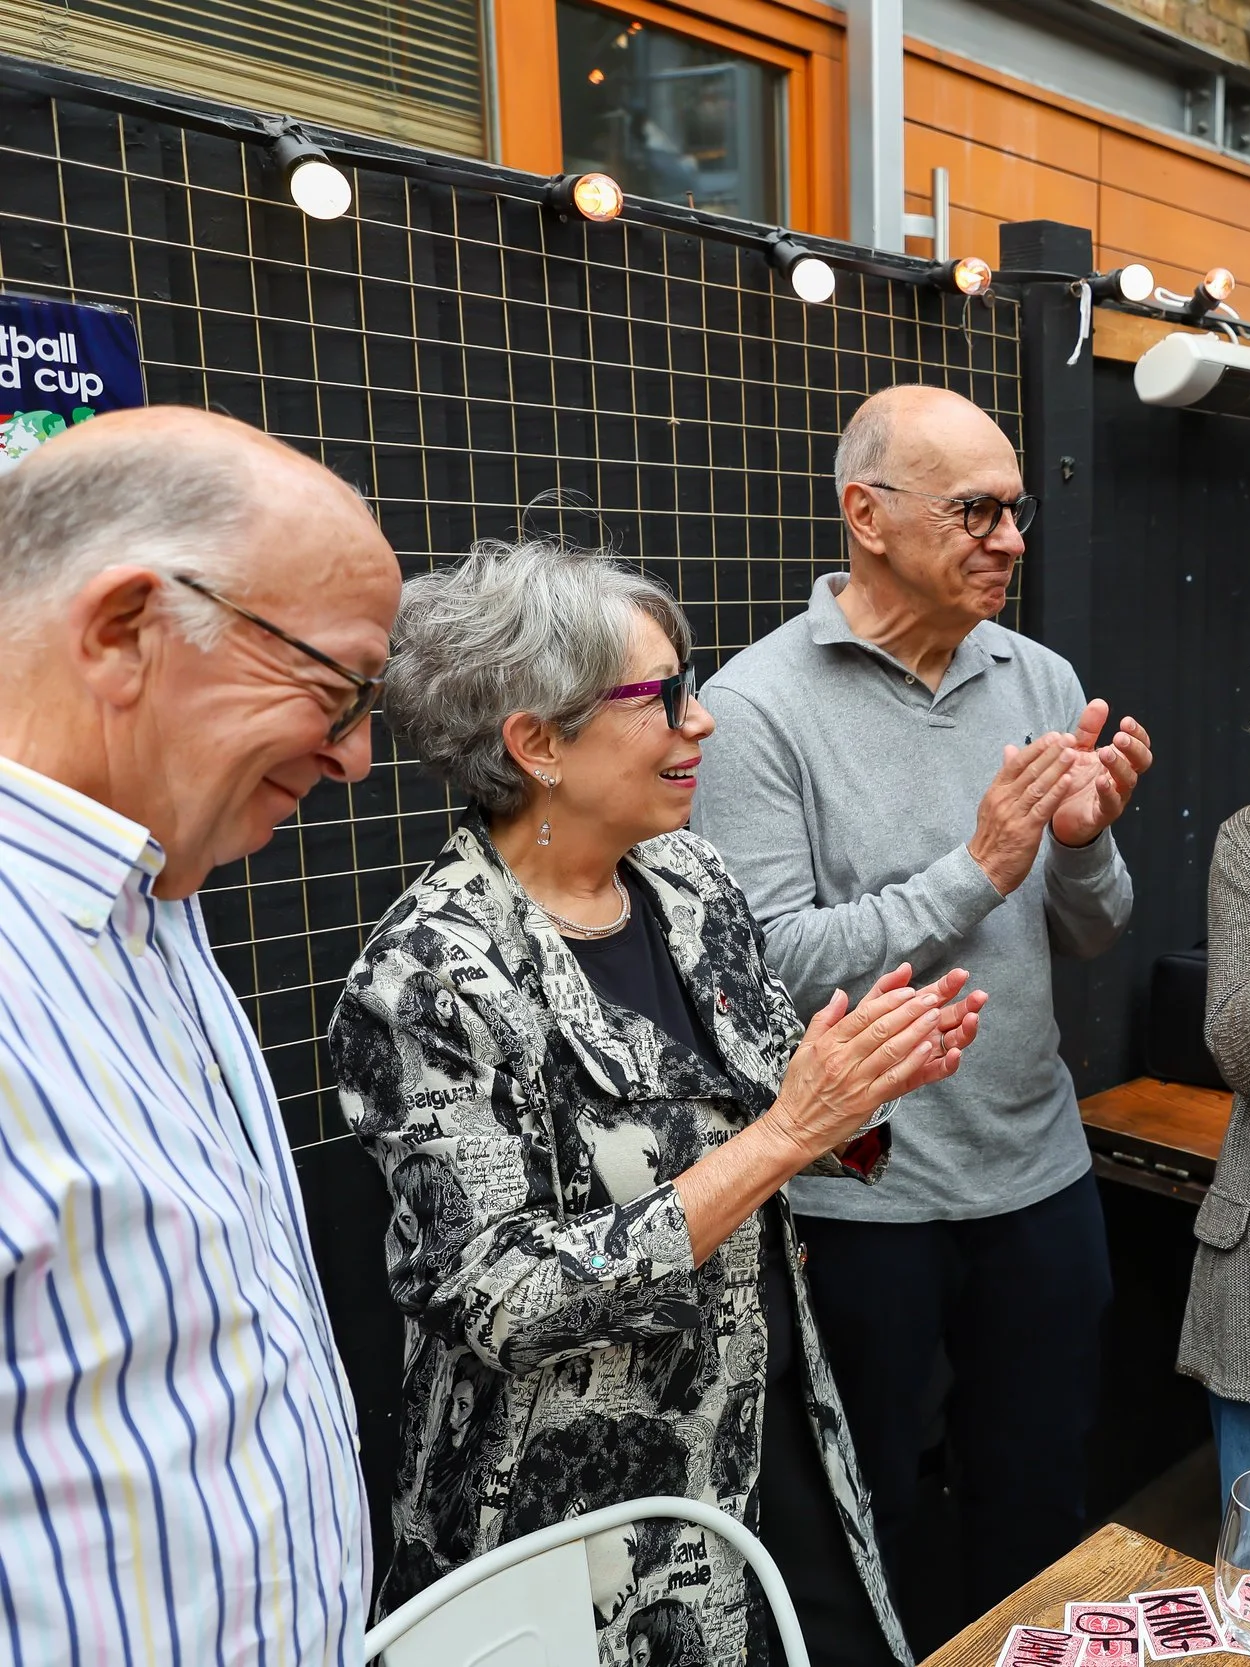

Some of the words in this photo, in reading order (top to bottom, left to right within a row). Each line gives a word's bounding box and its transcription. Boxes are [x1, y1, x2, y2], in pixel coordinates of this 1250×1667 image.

[34, 368, 104, 403] cup
[667, 1562, 712, 1591] made
[1076, 1612, 1139, 1654] OF
[1138, 1593, 1216, 1653] KING
